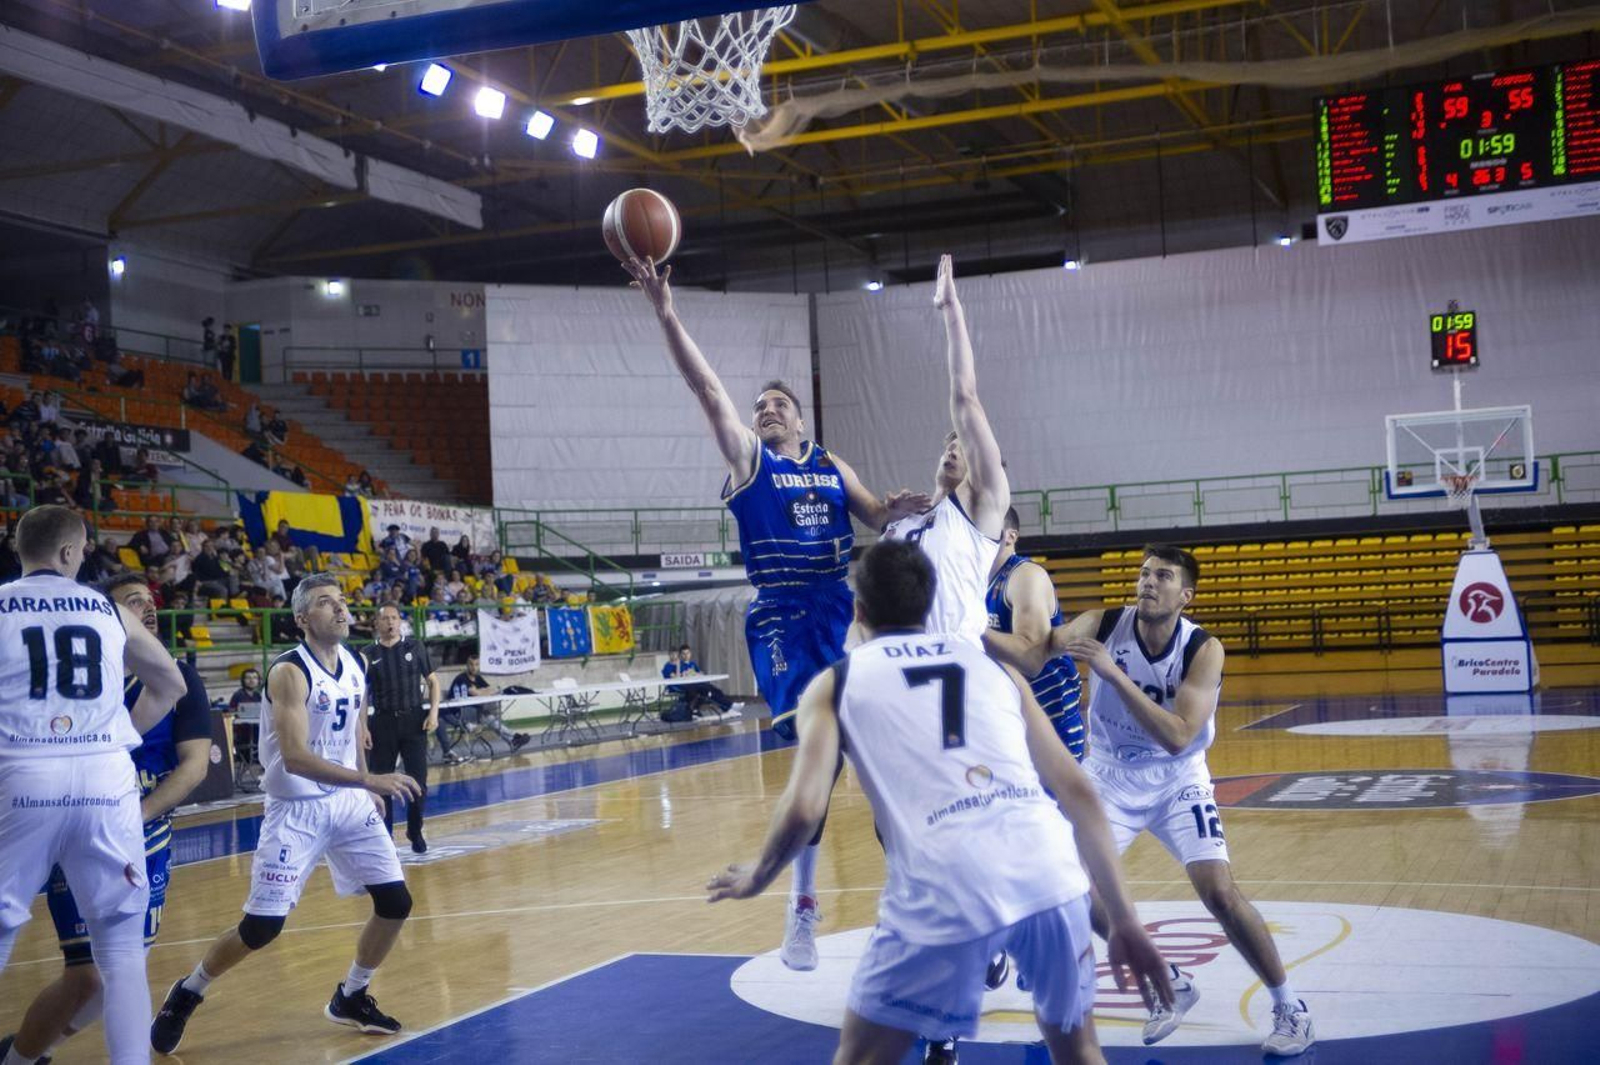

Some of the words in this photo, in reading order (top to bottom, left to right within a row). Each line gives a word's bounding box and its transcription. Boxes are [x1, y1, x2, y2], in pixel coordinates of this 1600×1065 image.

[1444, 96, 1469, 119] 59
[1508, 87, 1534, 110] 55
[1481, 110, 1493, 128] 3
[1460, 133, 1515, 159] 01:59
[1445, 172, 1458, 188] 4
[1520, 162, 1533, 180] 5
[1446, 332, 1472, 359] 15
[664, 555, 701, 566] SAIDA
[883, 642, 952, 658] DÍAZ
[21, 624, 103, 700] 18
[1458, 658, 1520, 668] BricoCentro
[332, 698, 349, 732] 5
[902, 662, 966, 750] 7
[1191, 804, 1224, 838] 12
